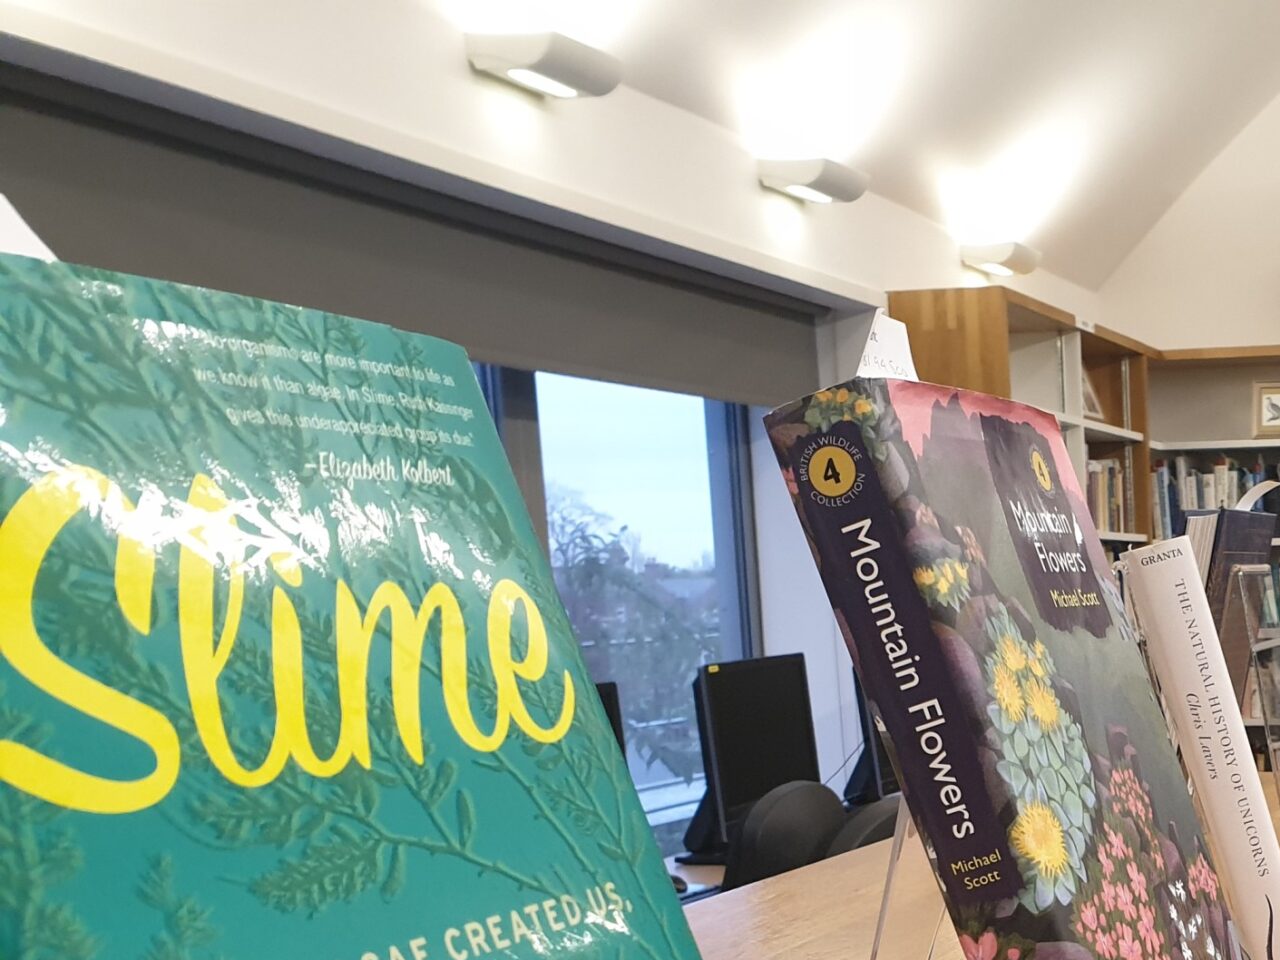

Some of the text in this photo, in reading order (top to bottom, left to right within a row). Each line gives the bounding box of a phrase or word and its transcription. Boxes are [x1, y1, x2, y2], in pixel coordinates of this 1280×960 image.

[301, 349, 322, 364] are
[324, 353, 356, 369] more
[359, 358, 411, 378] important
[413, 367, 424, 381] to
[425, 368, 441, 384] life
[443, 375, 455, 387] as
[192, 368, 216, 383] we
[217, 367, 258, 388] know
[261, 373, 272, 390] it
[273, 375, 304, 395] than
[427, 397, 475, 422] Kassinger
[226, 406, 264, 426] gives
[265, 410, 293, 428] this
[295, 415, 403, 438] underappreciated
[404, 426, 437, 444] group
[401, 458, 455, 486] Kolbert
[800, 435, 863, 482] BRITISH WILDLIFE
[824, 457, 841, 484] 4
[810, 472, 866, 507] COLLECTION
[1010, 499, 1073, 536] Mountain
[1034, 541, 1087, 573] Flowers
[1140, 548, 1183, 568] GRANTA
[1049, 587, 1100, 609] Michael Scott
[0, 464, 575, 814] Slime
[841, 518, 975, 840] Mountain Flowers
[1174, 578, 1269, 879] THE NATURAL HISTORY OF UNICORNS
[1185, 692, 1219, 780] Chris Lavers
[951, 848, 1002, 876] Michael
[964, 870, 1001, 890] Scott
